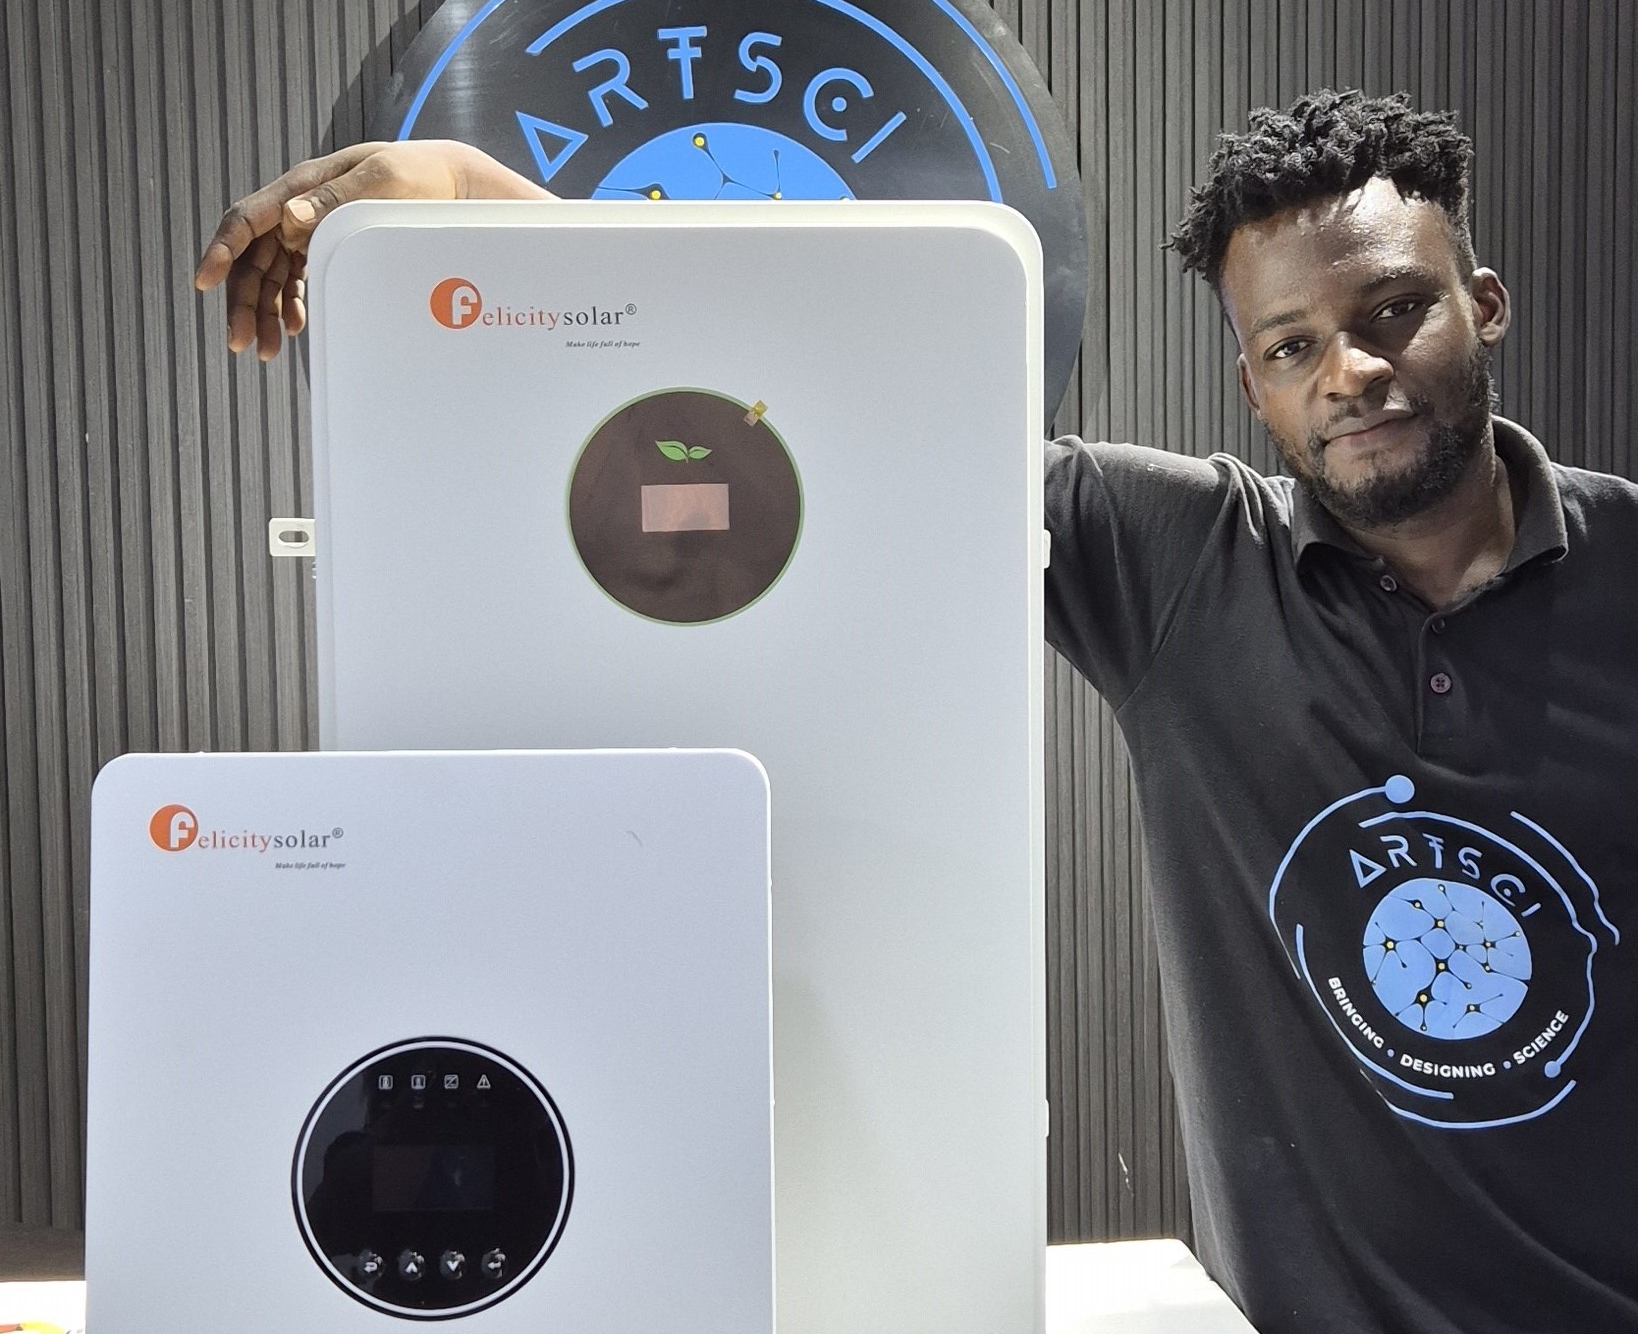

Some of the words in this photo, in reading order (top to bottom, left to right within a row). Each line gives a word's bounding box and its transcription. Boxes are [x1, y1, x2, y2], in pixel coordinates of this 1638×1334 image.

[565, 340, 585, 348] Make
[586, 340, 599, 349] life
[599, 340, 613, 349] full
[623, 340, 640, 349] hope
[1328, 977, 1384, 1050] BRINGING
[1400, 1054, 1496, 1078] DESIGNING
[1512, 1010, 1569, 1065] SCIENCE
